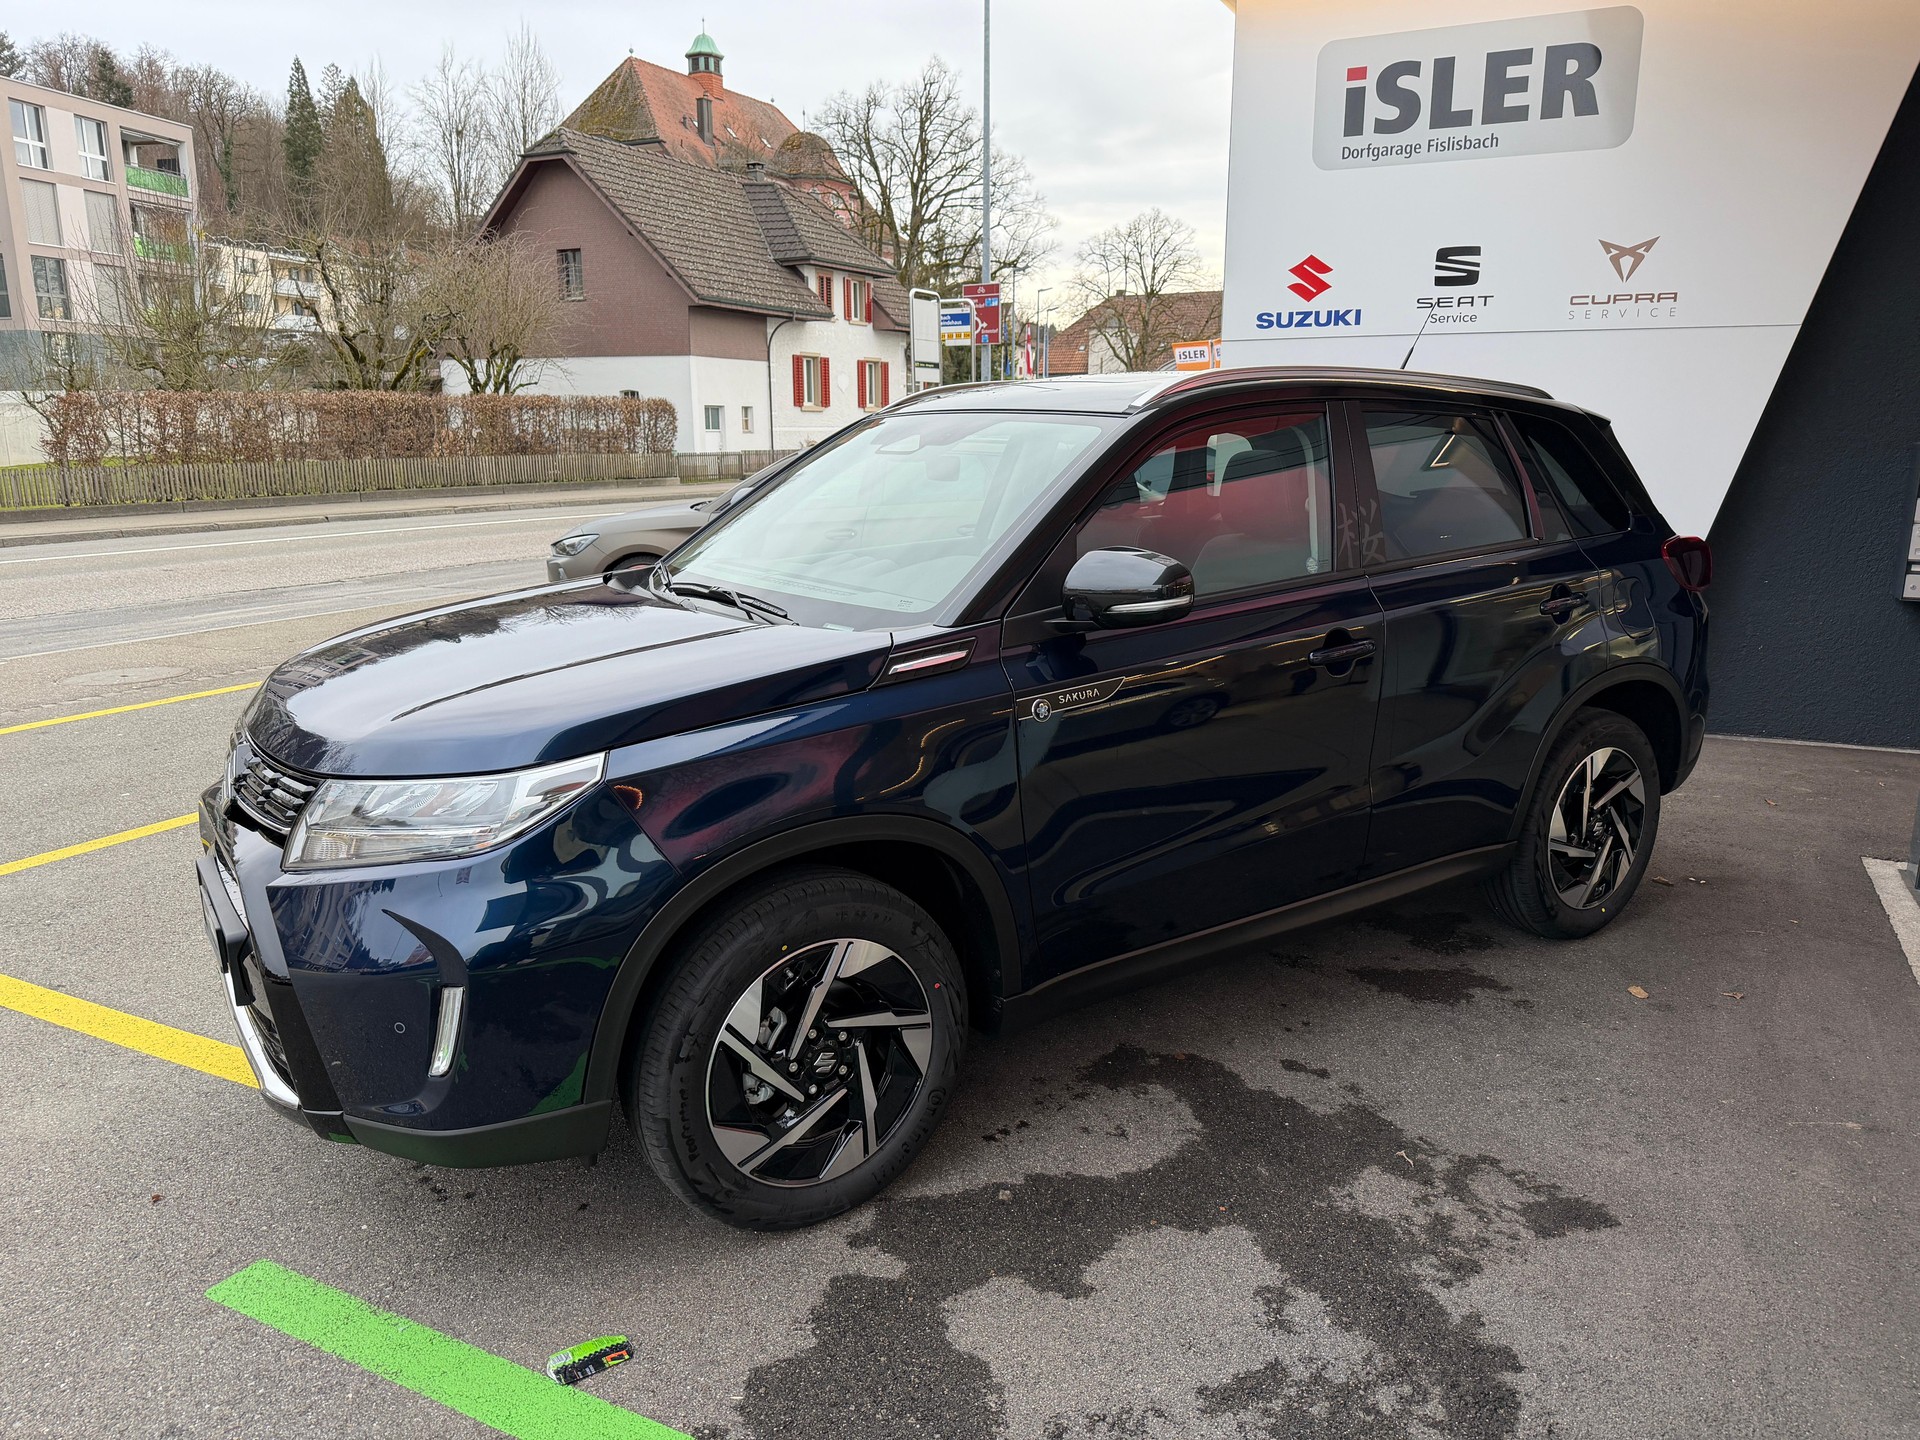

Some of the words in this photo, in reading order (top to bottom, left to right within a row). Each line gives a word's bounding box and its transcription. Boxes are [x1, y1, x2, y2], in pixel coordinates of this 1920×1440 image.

[1343, 42, 1603, 138] iSLER
[1341, 140, 1422, 161] Dorfgarage
[1427, 132, 1499, 153] Fislisbach
[1416, 295, 1494, 309] SEAT
[1569, 292, 1678, 306] CUPRA
[1255, 308, 1362, 330] SUZUKI
[1430, 312, 1478, 324] Service
[1568, 307, 1677, 320] SERVICE
[1178, 349, 1206, 360] iSLER
[1337, 498, 1387, 569] 桜
[1058, 688, 1100, 704] SAKURA
